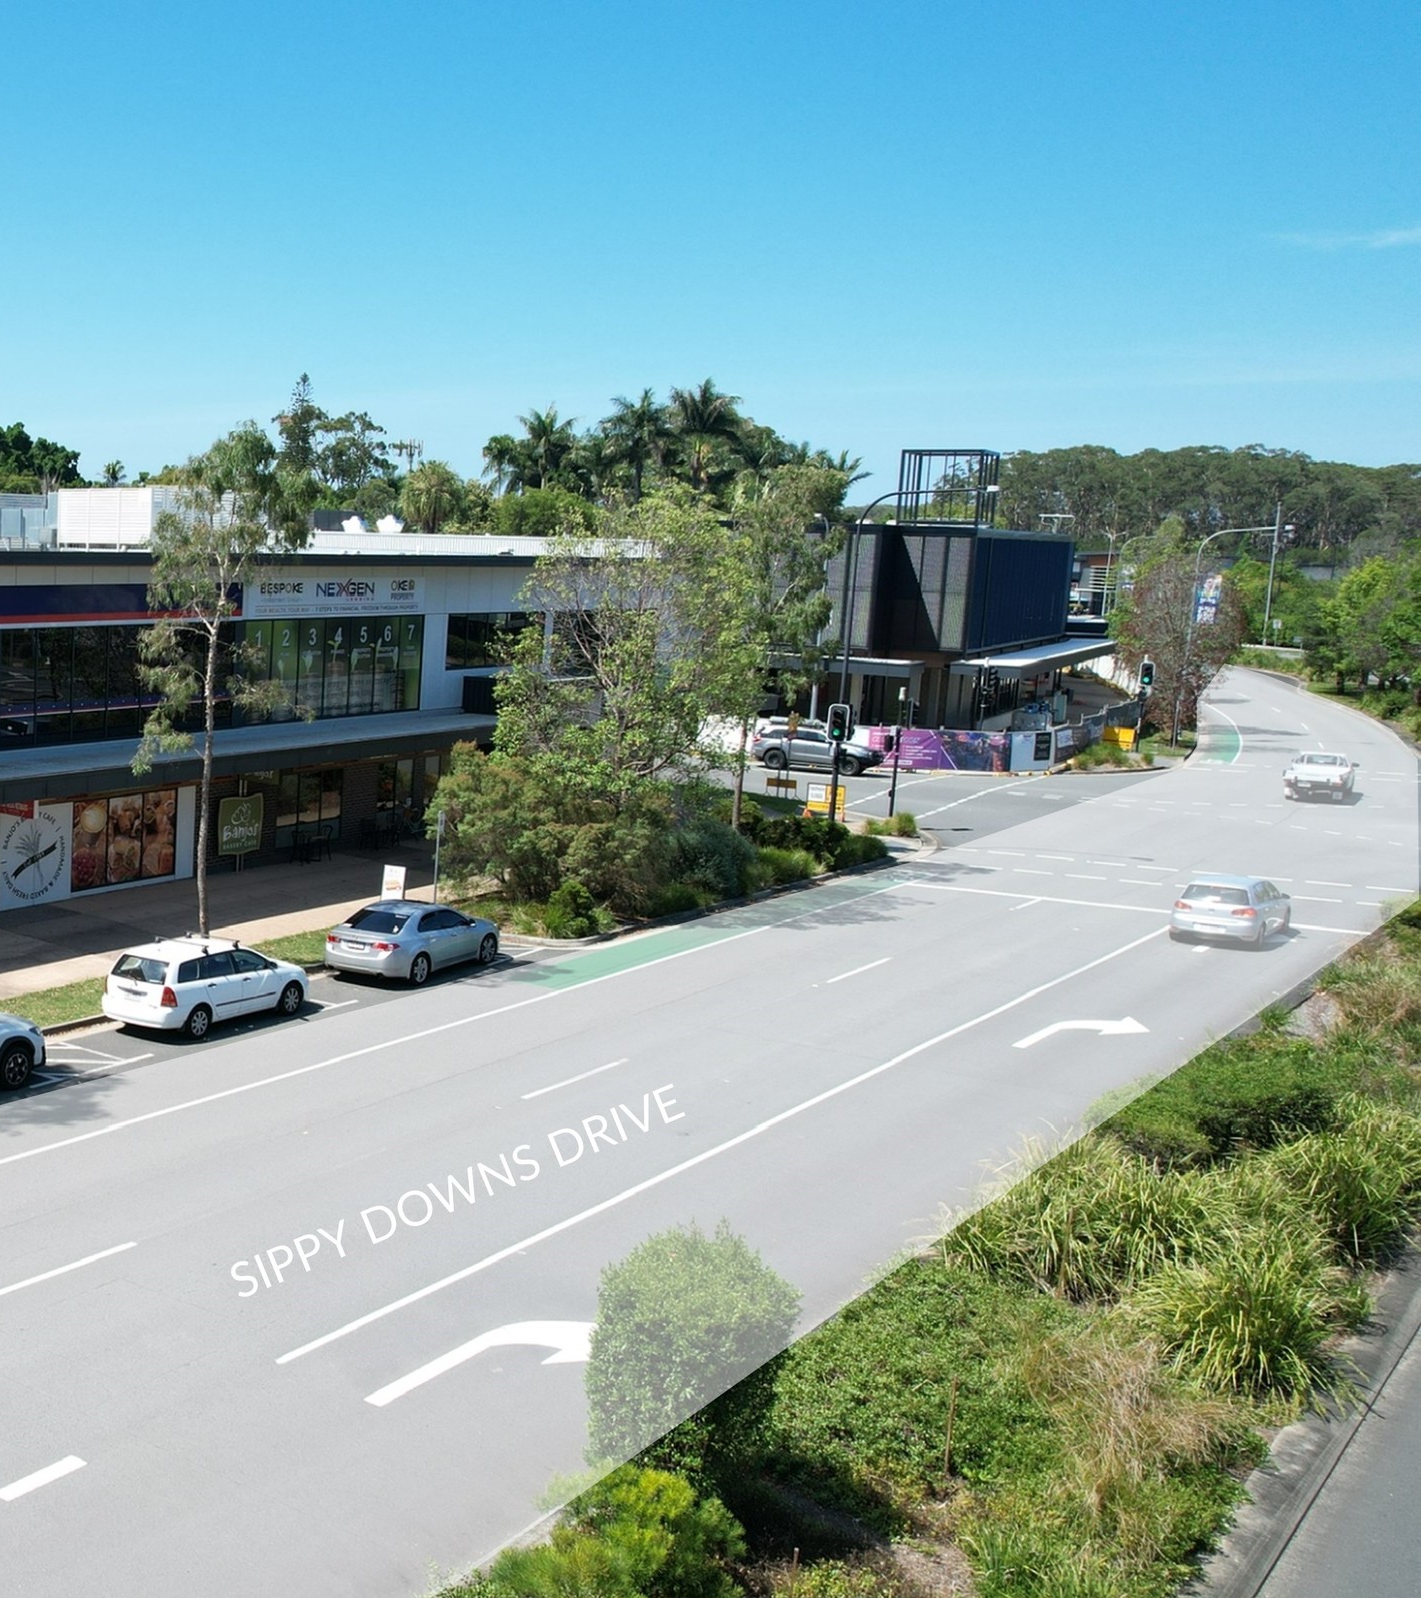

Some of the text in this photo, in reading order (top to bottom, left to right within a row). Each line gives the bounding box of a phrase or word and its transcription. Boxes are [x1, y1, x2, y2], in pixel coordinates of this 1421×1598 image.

[260, 583, 303, 594] BESPOKE
[390, 592, 414, 600] PROPERTY
[255, 630, 262, 648] 1
[282, 629, 290, 647] 2
[309, 628, 317, 645] 3
[334, 627, 343, 644] 4
[359, 626, 368, 643] 5
[384, 625, 392, 642] 6
[407, 624, 415, 640] 7
